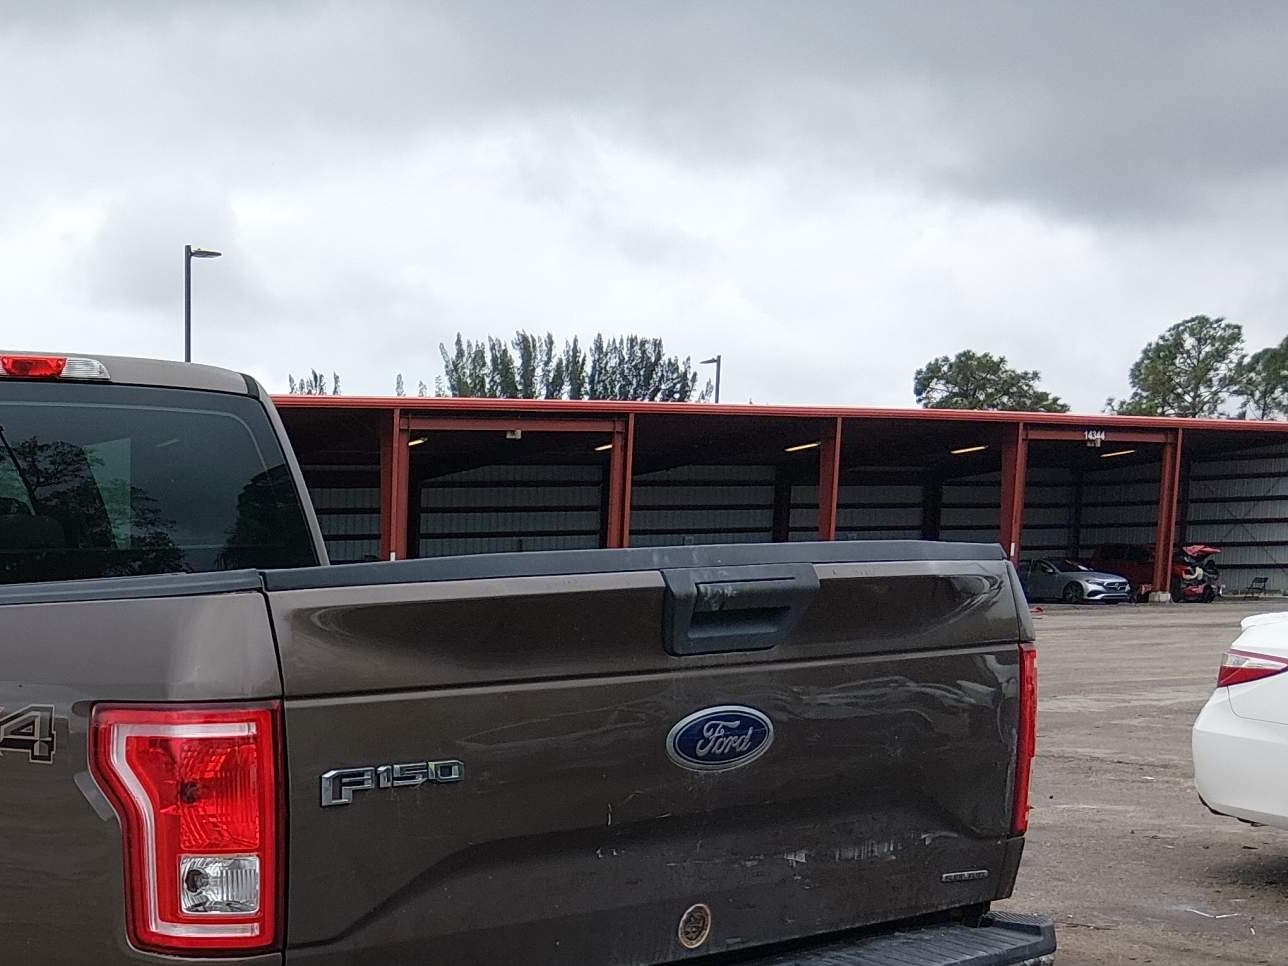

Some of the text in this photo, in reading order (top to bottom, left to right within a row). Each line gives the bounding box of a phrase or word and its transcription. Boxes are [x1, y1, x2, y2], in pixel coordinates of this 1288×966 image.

[1084, 430, 1106, 440] 14344
[695, 720, 754, 757] Ford
[321, 759, 465, 807] F150
